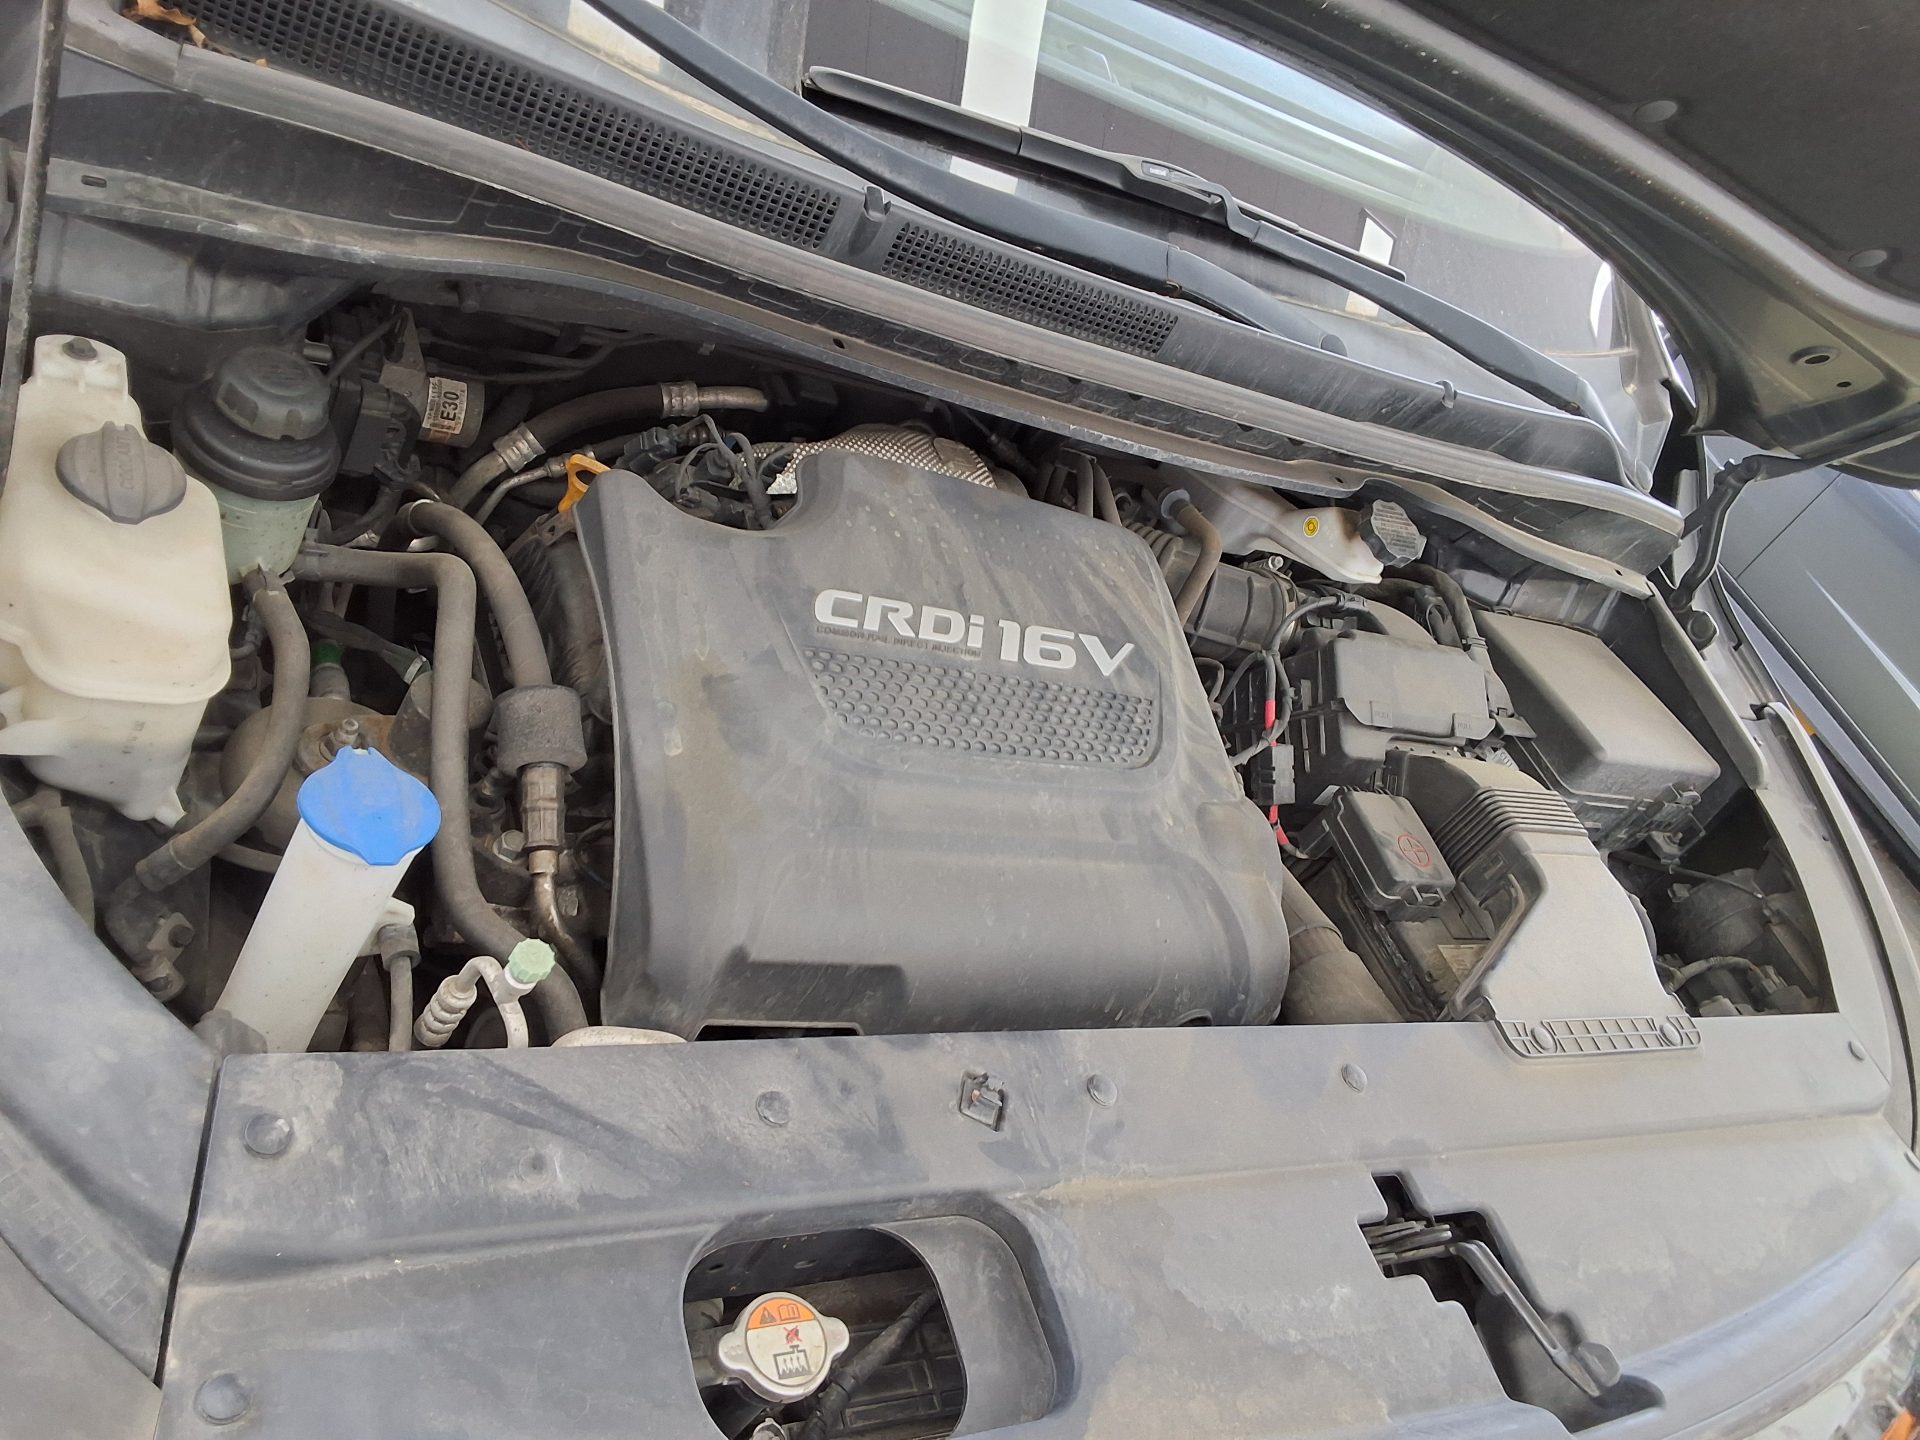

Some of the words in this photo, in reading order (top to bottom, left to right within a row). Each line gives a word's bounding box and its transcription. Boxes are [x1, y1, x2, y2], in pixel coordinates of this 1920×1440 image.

[440, 391, 459, 421] E30
[814, 588, 985, 648] CRDi
[998, 619, 1135, 677] 16V
